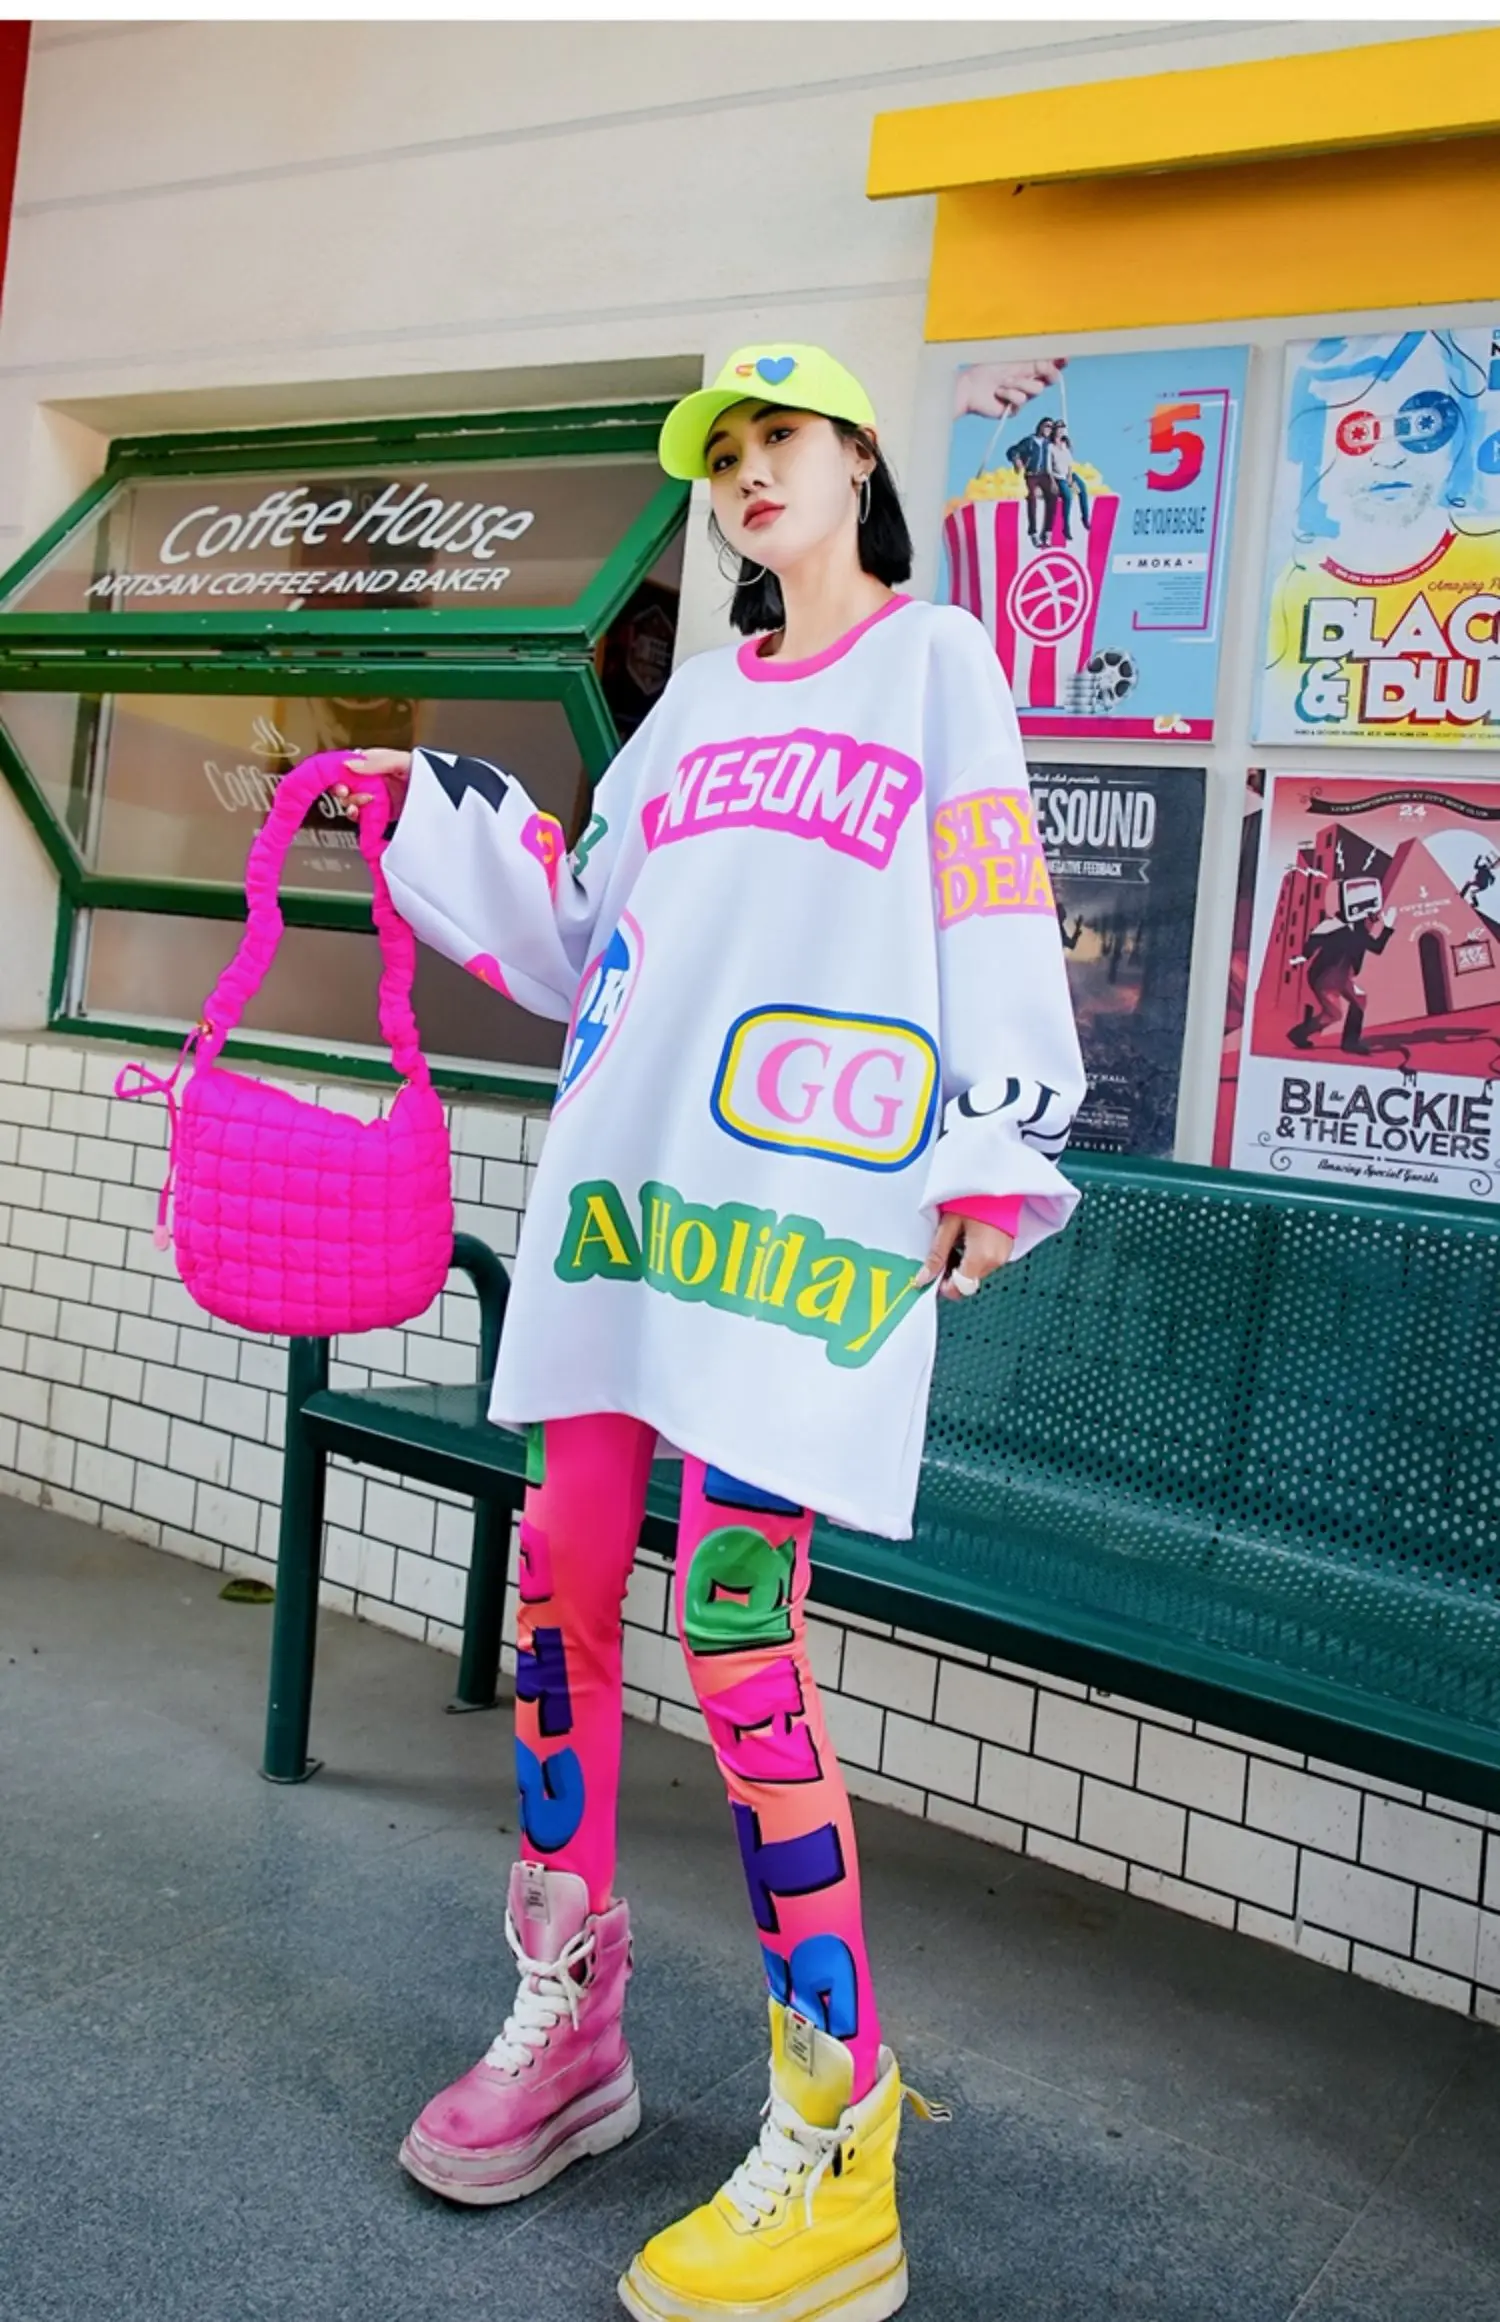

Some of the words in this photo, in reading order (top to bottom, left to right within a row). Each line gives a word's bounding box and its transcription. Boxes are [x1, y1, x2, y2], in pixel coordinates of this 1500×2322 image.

[1146, 403, 1205, 491] 5
[159, 487, 353, 564] Coffee
[343, 483, 535, 559] House
[85, 573, 207, 597] ARTISAN
[208, 571, 320, 595] COFFEE
[320, 570, 399, 594] AND
[398, 567, 510, 592] BAKER
[1137, 558, 1182, 568] MOKA
[1295, 659, 1349, 723] &
[1399, 803, 1427, 816] 24
[1083, 861, 1122, 876] FEEDBACK
[756, 1037, 905, 1139] GG
[1280, 1077, 1493, 1135] BLACKIE
[1276, 1116, 1295, 1138] &
[1300, 1117, 1358, 1146] THE
[1366, 1125, 1490, 1161] LOVERS
[1317, 1159, 1362, 1176] Amazing
[1363, 1163, 1402, 1179] Special
[572, 1196, 632, 1268] A
[648, 1197, 920, 1352] Holiday
